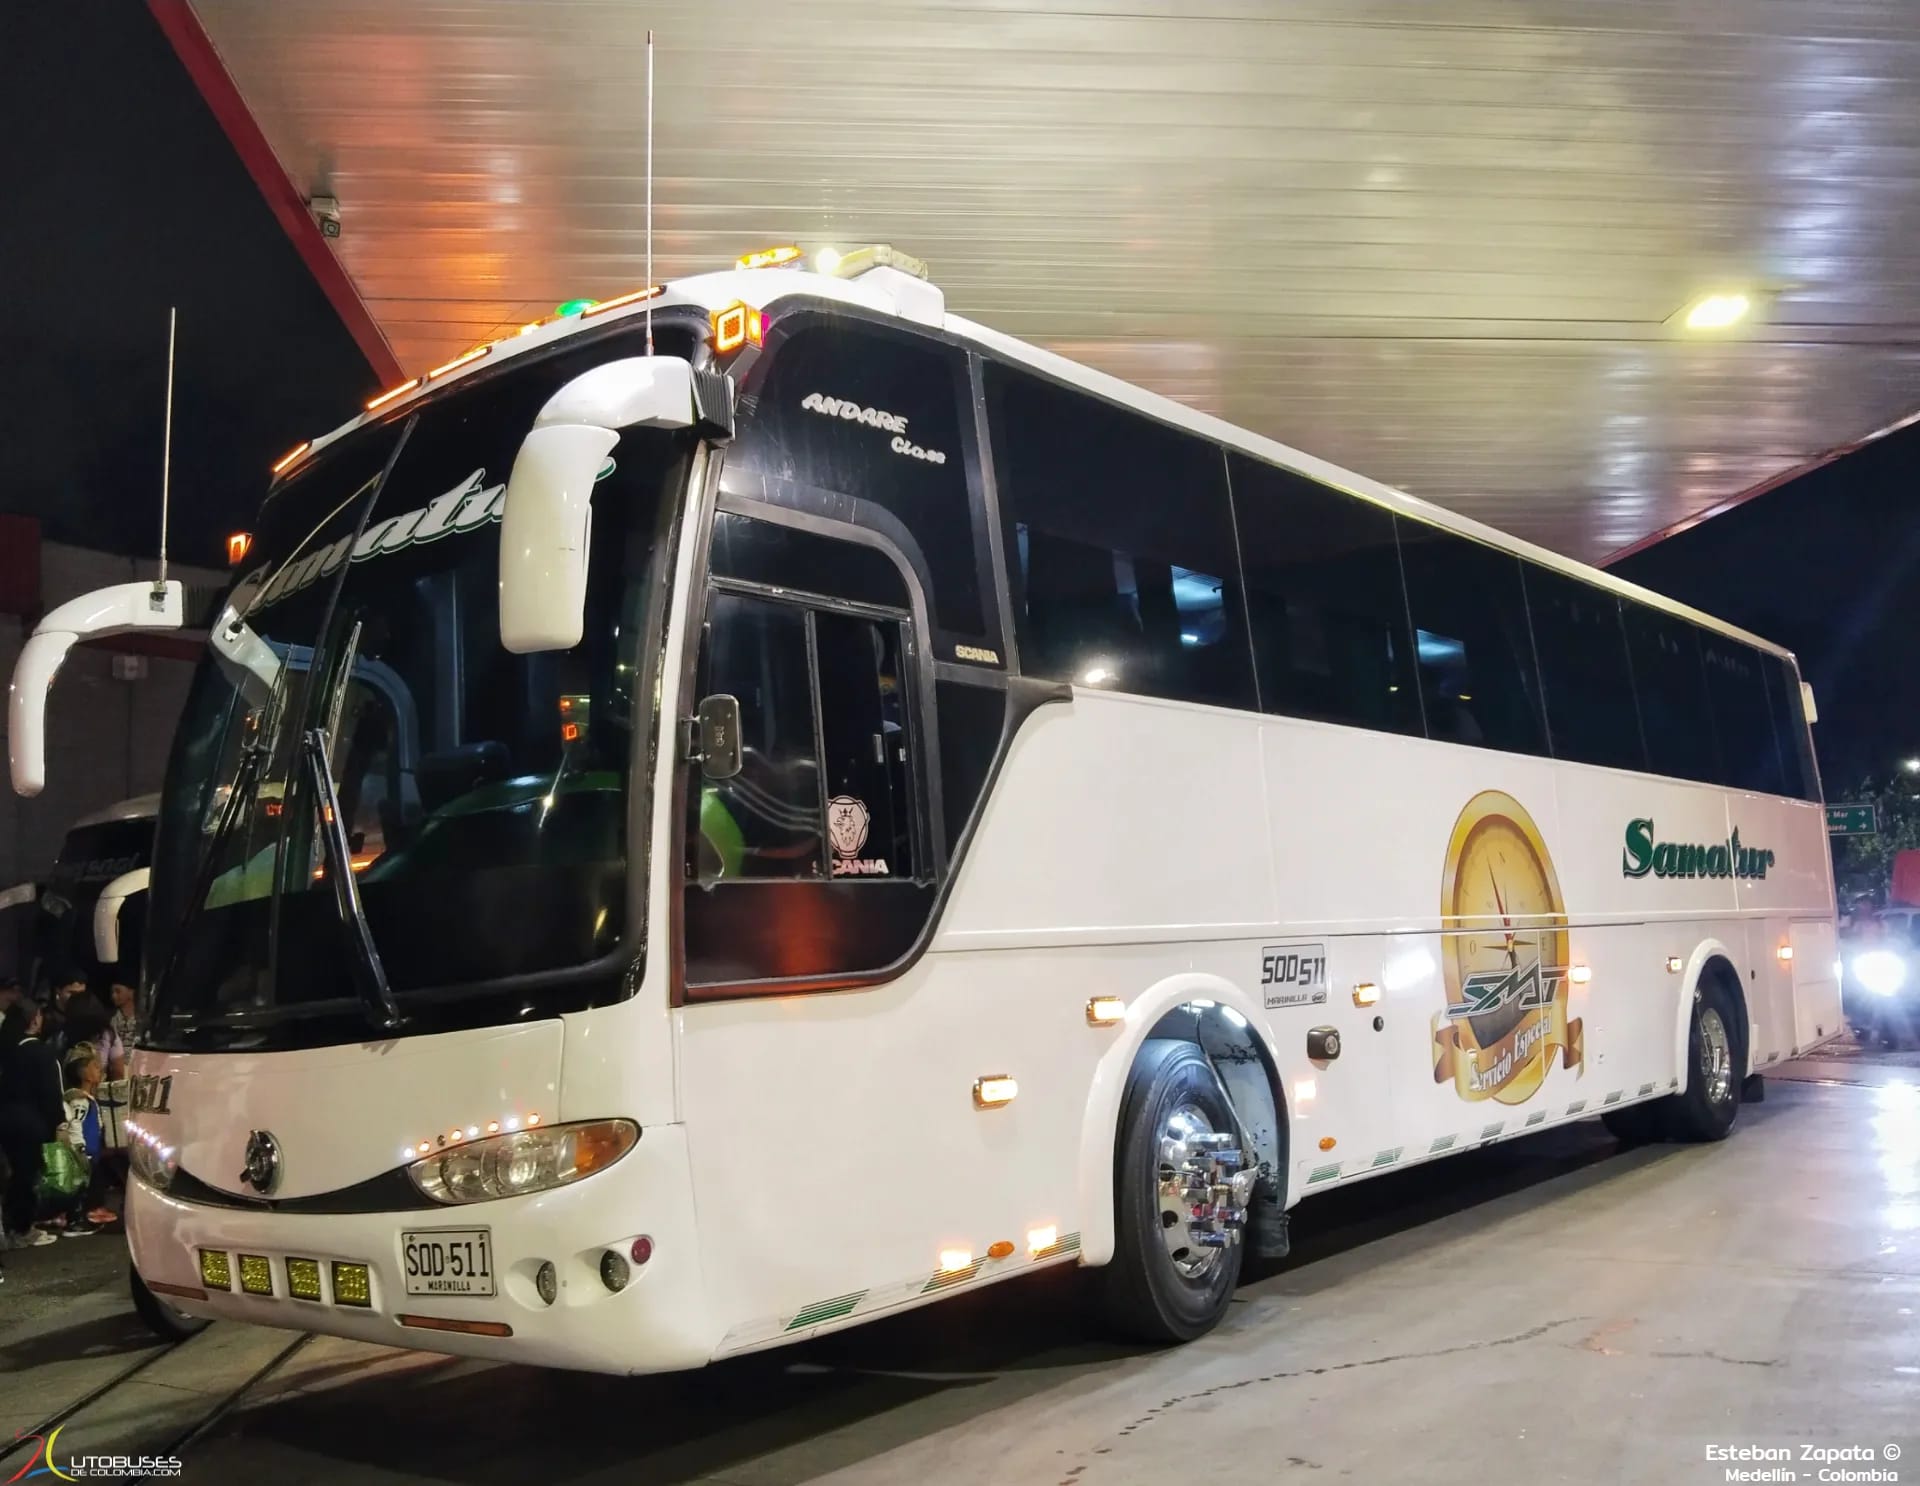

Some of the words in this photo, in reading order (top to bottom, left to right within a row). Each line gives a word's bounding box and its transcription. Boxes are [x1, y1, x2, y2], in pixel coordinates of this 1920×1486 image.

[802, 393, 908, 434] ANDARE
[955, 644, 999, 664] SCANIA
[1623, 818, 1775, 880] Samatur
[1470, 1048, 1512, 1091] Servicio
[1514, 1014, 1551, 1063] Especial
[74, 1108, 86, 1120] 17
[428, 1280, 471, 1292] MARINILLA
